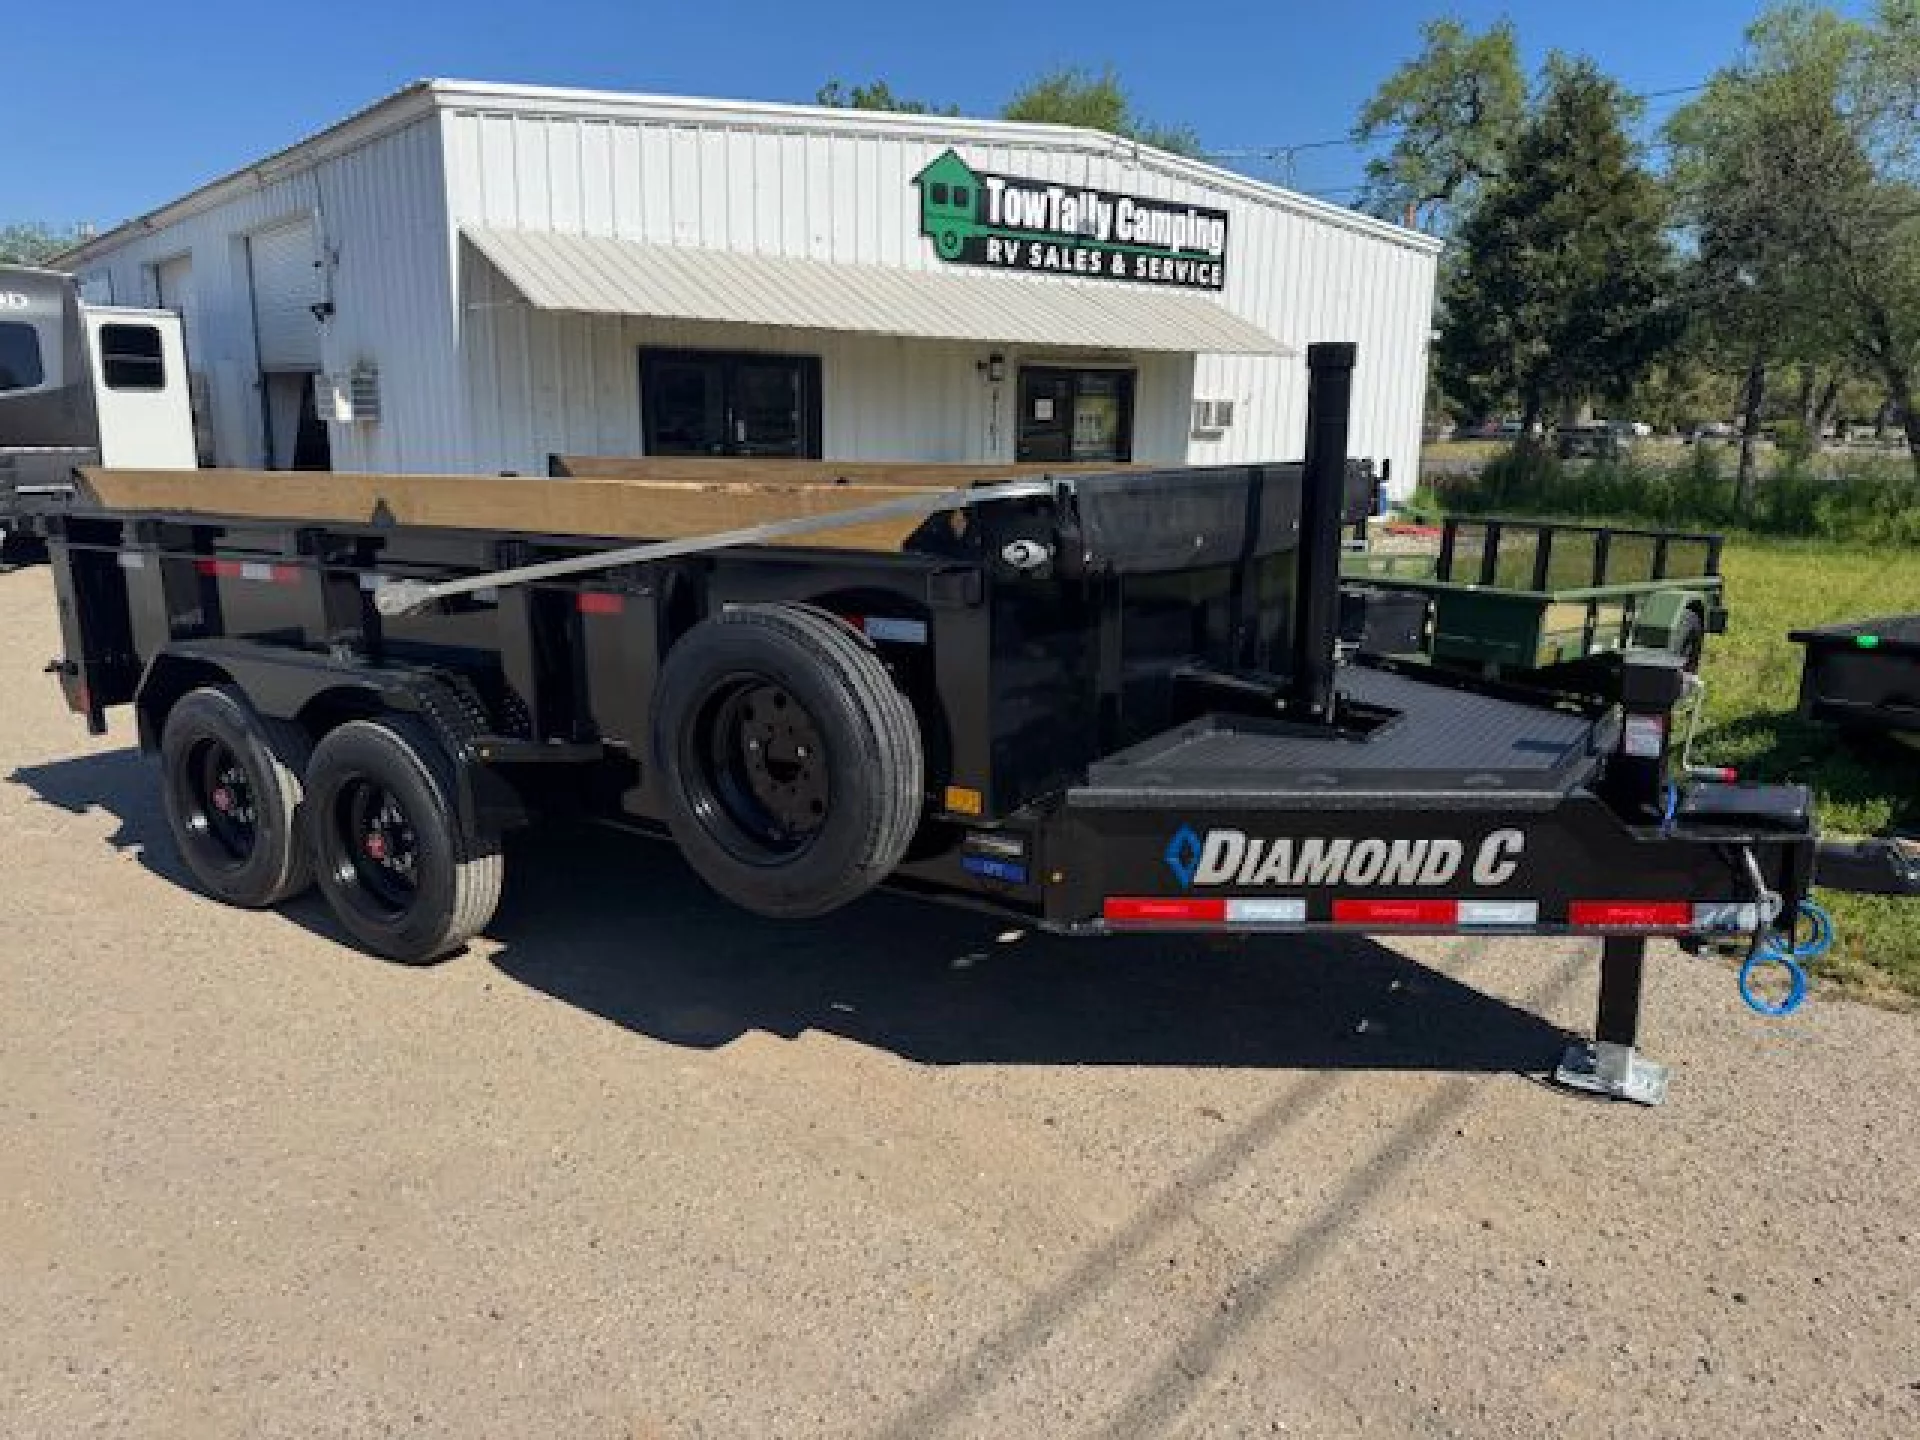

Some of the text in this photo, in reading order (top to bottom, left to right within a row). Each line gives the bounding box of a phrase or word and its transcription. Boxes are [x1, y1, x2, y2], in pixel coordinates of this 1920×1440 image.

[986, 177, 1225, 255] TowTally Camping
[986, 238, 1223, 286] RV SALES & SERVICE
[1472, 829, 1525, 885] C
